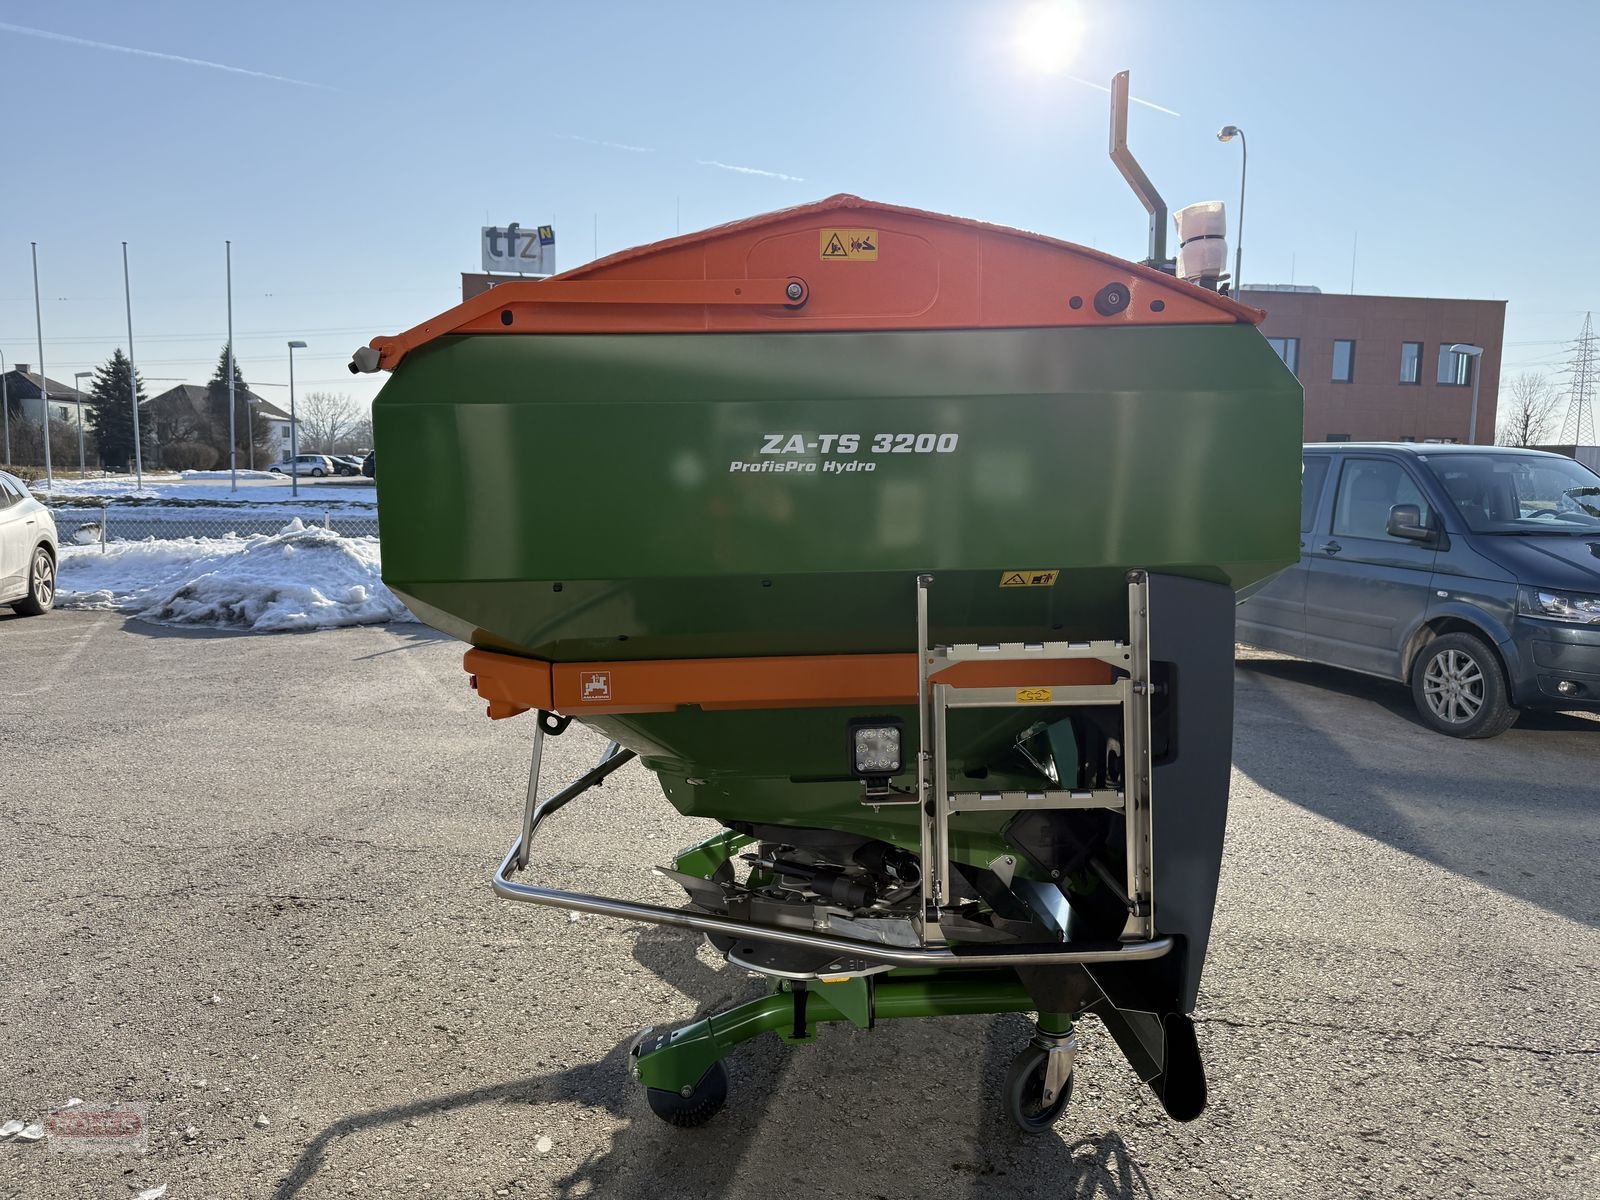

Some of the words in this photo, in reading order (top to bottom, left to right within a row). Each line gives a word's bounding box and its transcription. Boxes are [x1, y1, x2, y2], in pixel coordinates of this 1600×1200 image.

[486, 222, 537, 258] tfz
[540, 227, 551, 239] N
[760, 434, 861, 454] ZA-TS
[871, 433, 959, 453] 3200
[729, 460, 817, 473] ProfisPro
[823, 460, 876, 474] Hydro
